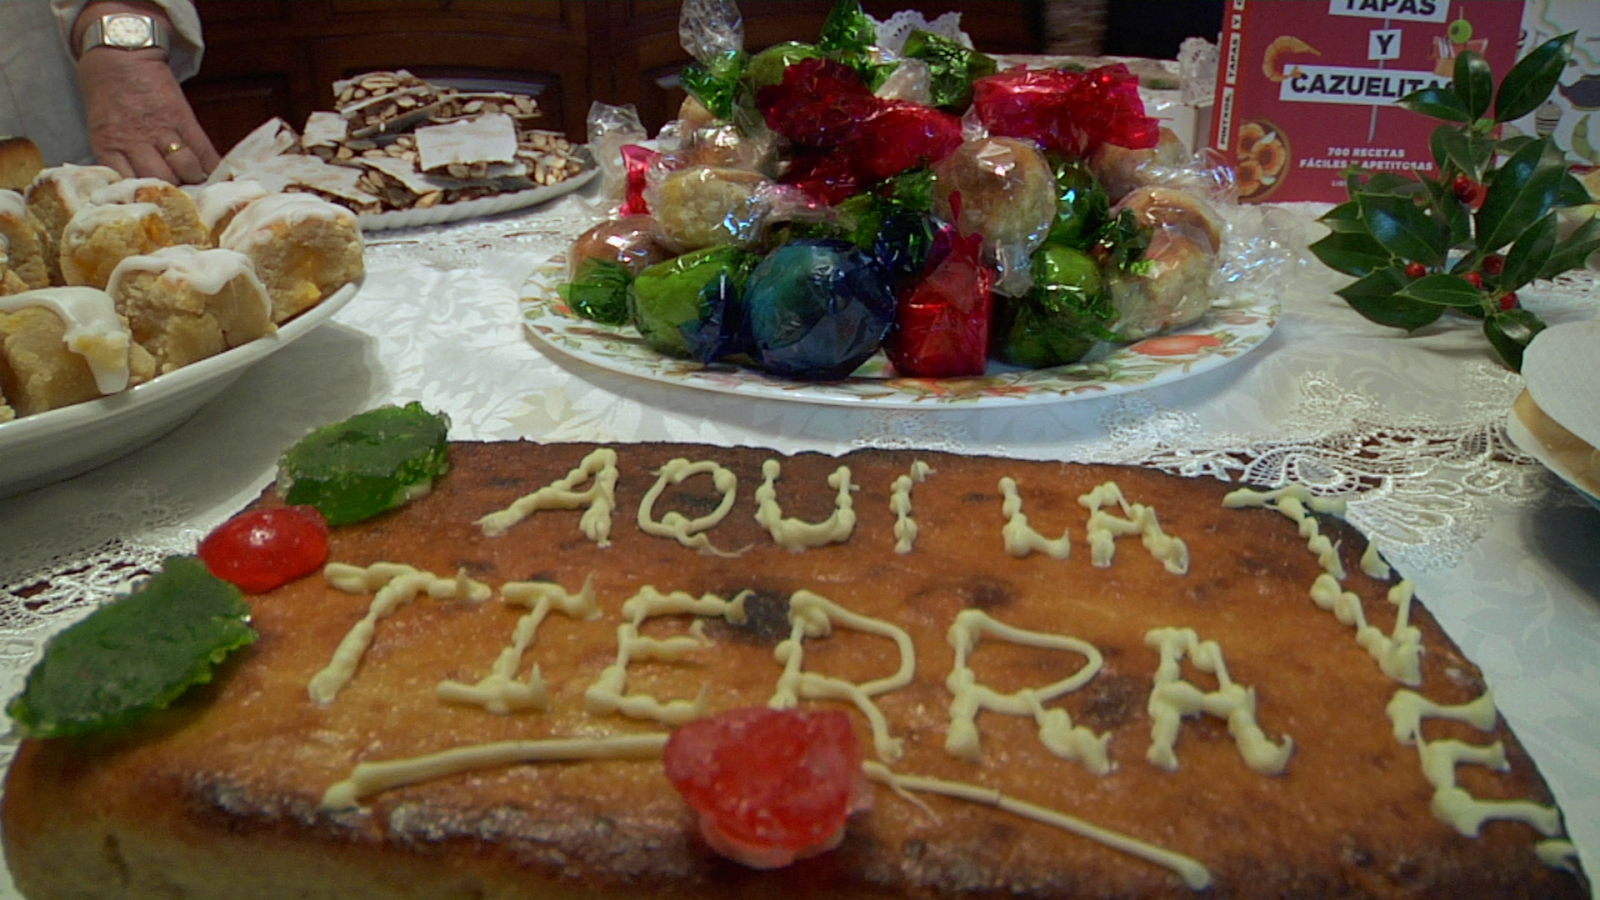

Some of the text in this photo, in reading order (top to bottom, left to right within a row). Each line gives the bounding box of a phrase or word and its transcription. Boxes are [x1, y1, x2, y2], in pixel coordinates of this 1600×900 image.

[1376, 34, 1394, 55] Y
[1328, 147, 1405, 157] 700 RECETAS
[1000, 476, 1189, 575] LA
[308, 562, 1294, 776] TIERRA
